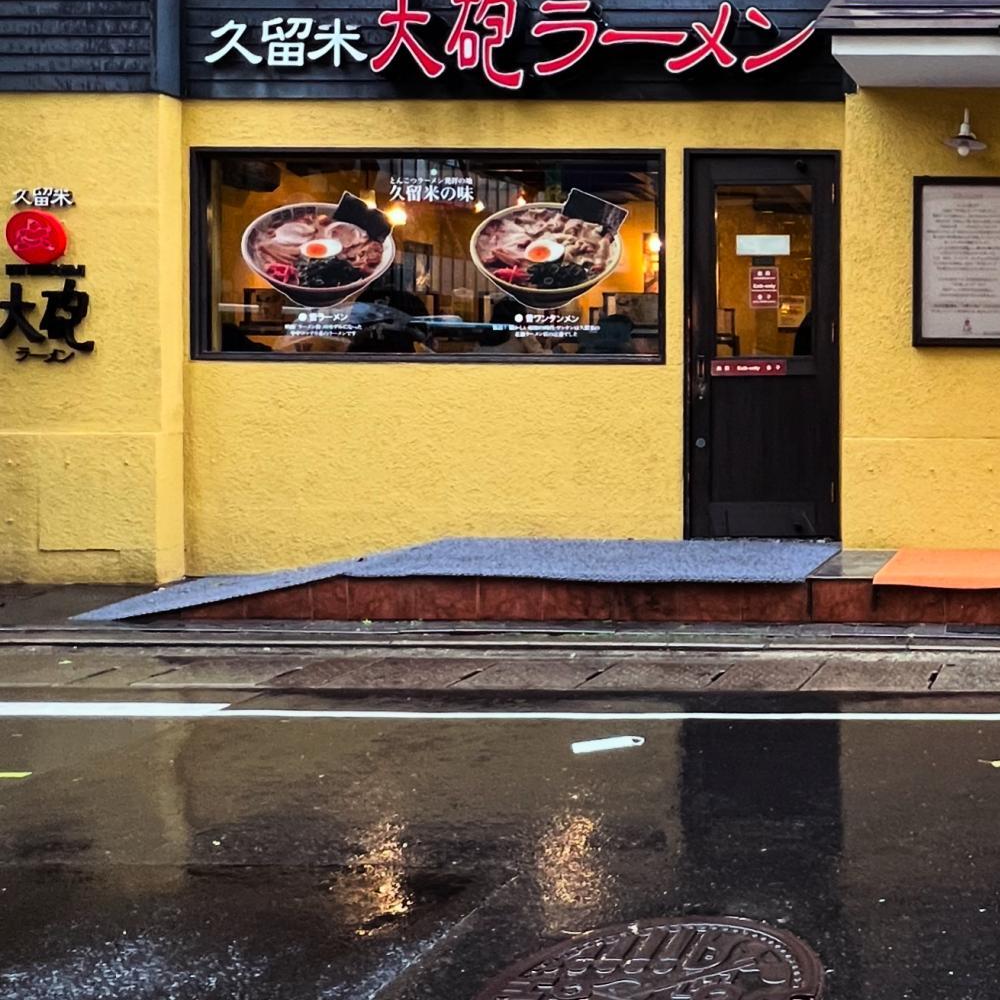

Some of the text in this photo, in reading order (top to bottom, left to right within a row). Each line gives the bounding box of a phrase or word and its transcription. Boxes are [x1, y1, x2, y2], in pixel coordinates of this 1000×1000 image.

[11, 188, 74, 207] 久留米
[389, 185, 475, 202] 久留米の味
[0, 279, 95, 353] 大砲
[15, 346, 76, 363] ラーメン
